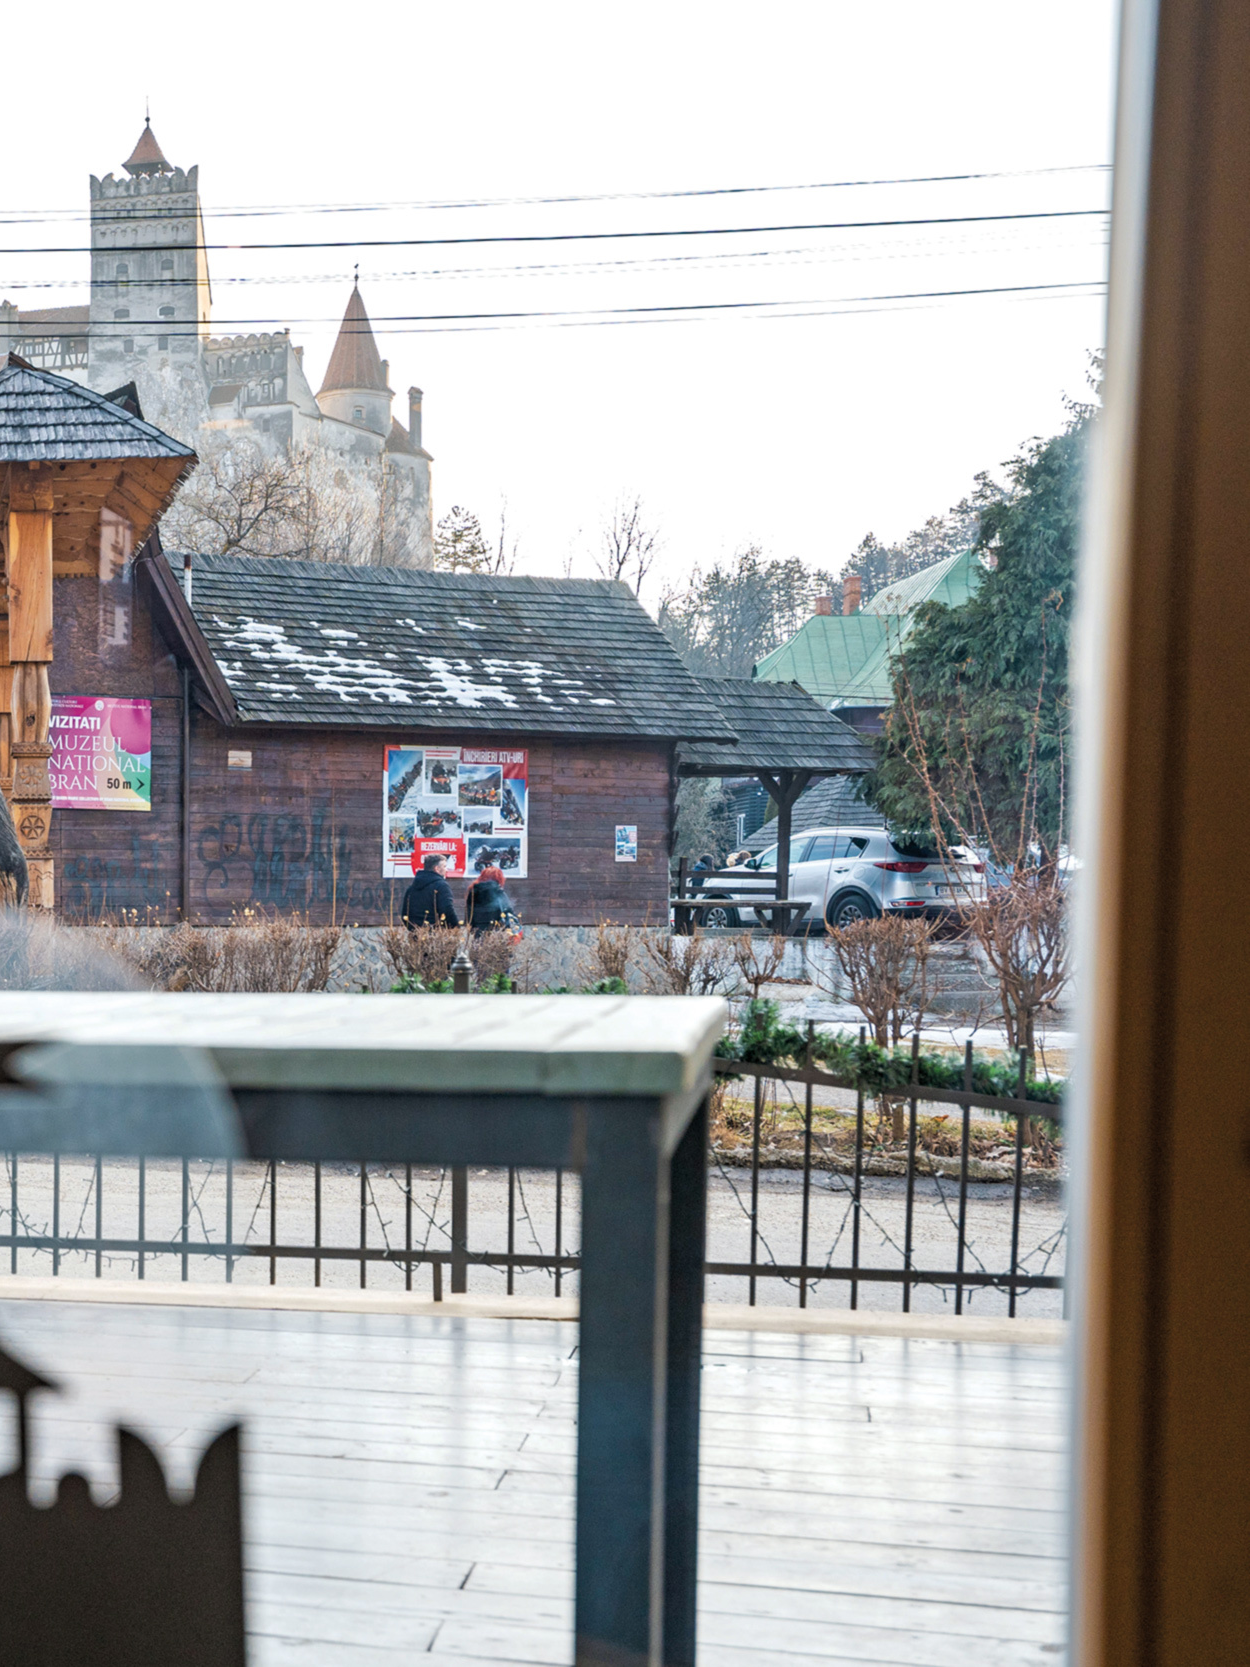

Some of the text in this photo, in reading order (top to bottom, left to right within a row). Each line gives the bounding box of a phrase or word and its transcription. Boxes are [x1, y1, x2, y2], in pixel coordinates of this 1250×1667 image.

[48, 734, 126, 753] MUZEUL
[47, 754, 146, 774] NAȚIONAL
[48, 773, 98, 790] BRAN
[107, 778, 132, 789] 50 m
